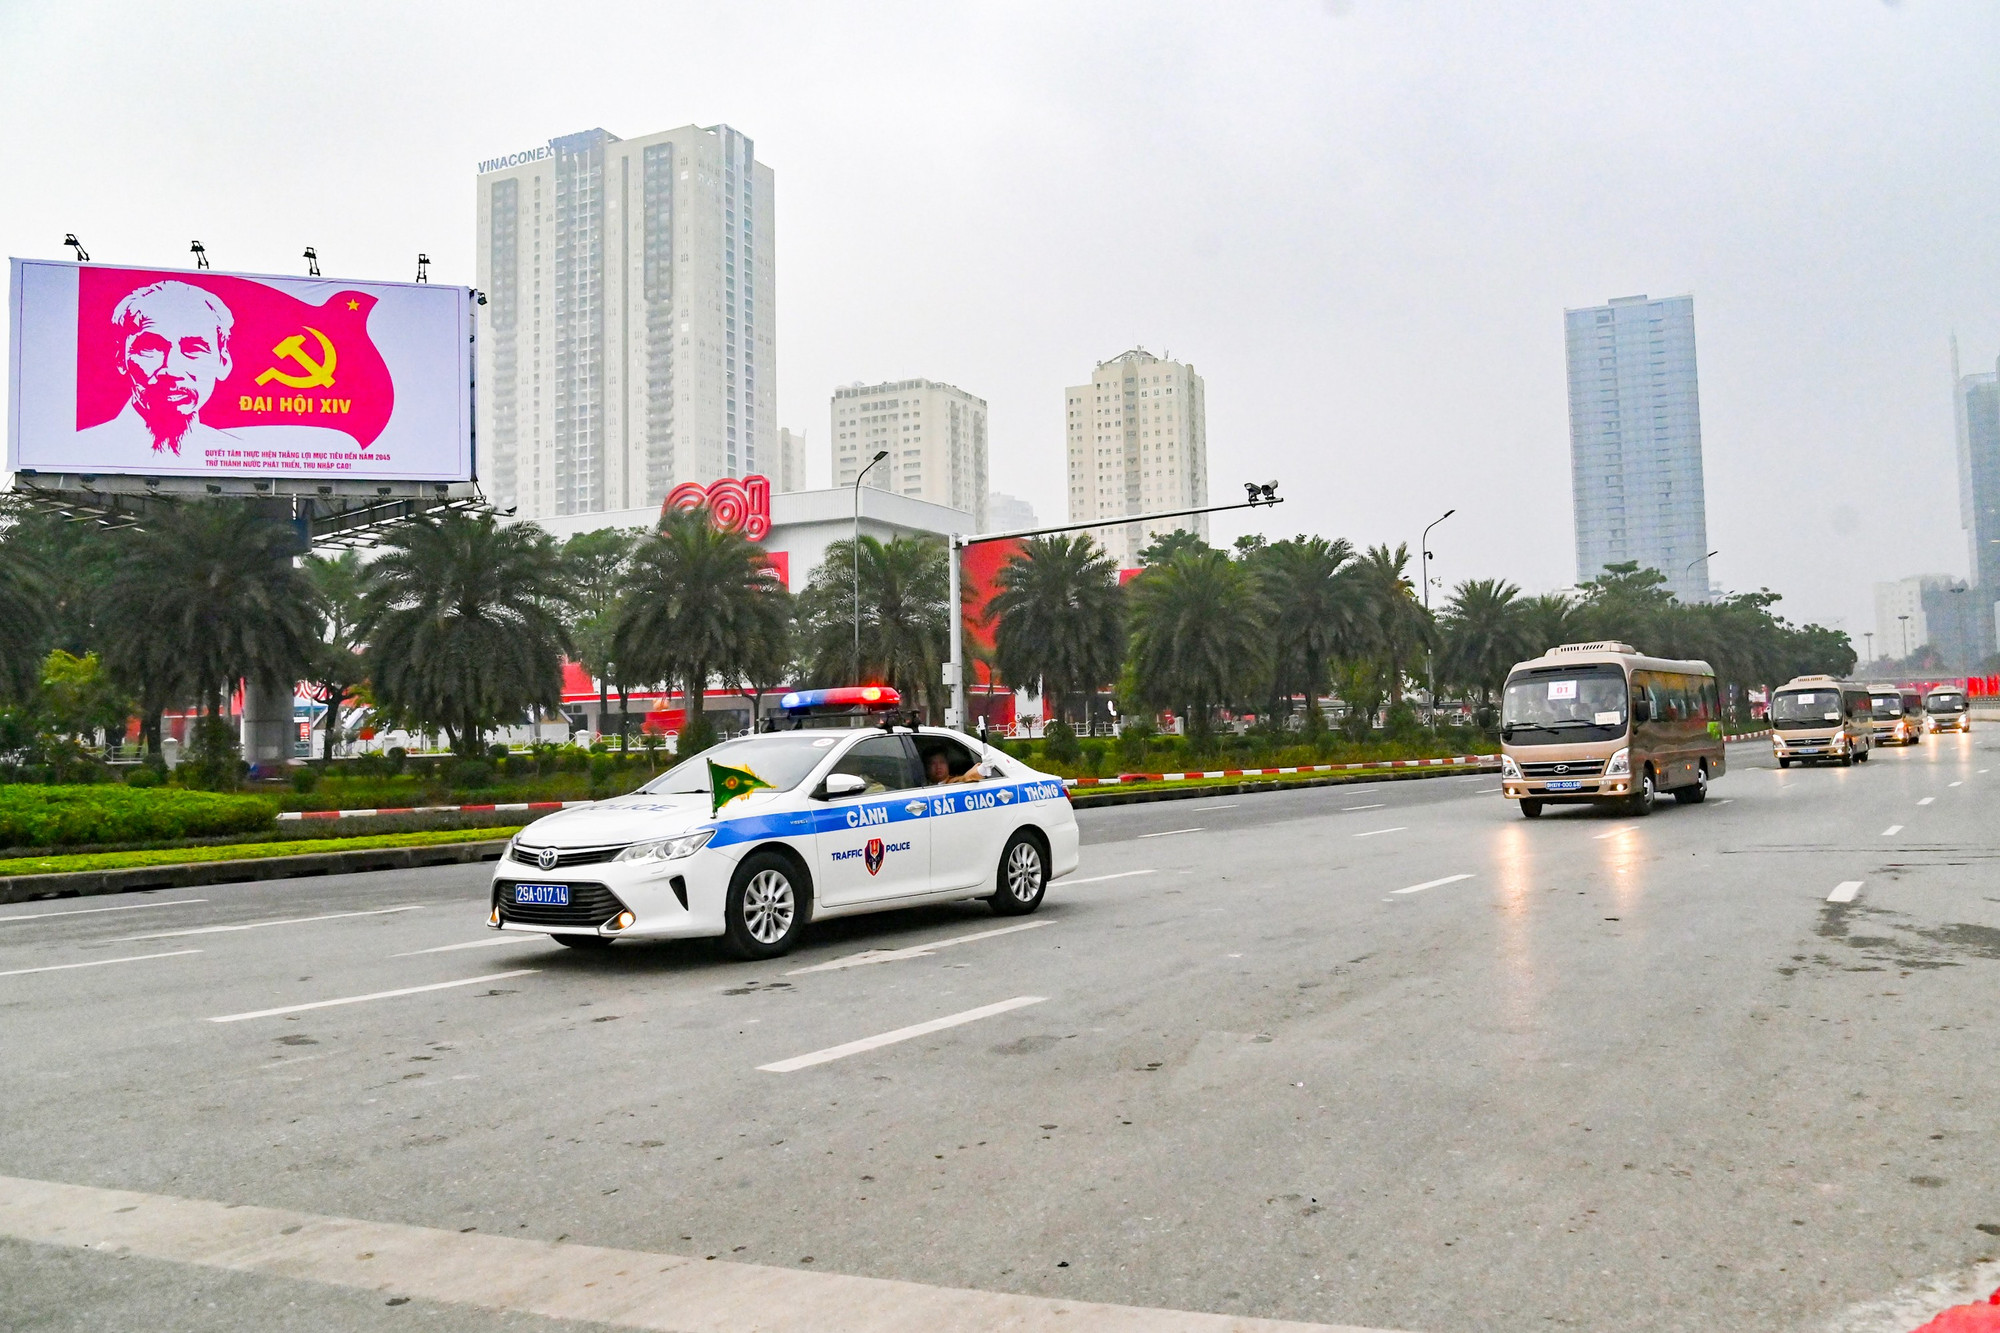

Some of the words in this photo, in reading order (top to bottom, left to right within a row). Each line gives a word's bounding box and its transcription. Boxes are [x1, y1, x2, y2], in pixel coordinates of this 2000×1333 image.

[478, 145, 554, 173] VINACONEX
[239, 395, 272, 415] ĐẠI
[280, 394, 313, 416] HỘI
[320, 398, 351, 414] XIV
[205, 447, 225, 457] QUYẾT
[227, 448, 241, 457] TÂM
[243, 450, 260, 459] THỰC
[261, 450, 277, 459] HIỆN
[278, 449, 299, 459] THẮNG
[301, 452, 311, 460] LỢI
[313, 452, 327, 460] MỤC
[329, 451, 343, 460] TIÊU
[344, 451, 357, 460] ĐẾN
[358, 452, 374, 460] NĂM
[375, 453, 391, 461] 2045
[205, 457, 219, 467] TRỞ
[220, 458, 241, 467] THÀNH
[242, 458, 261, 468] NƯỚC
[262, 460, 280, 468] PHÁT
[281, 459, 301, 469] TRIỂN,
[317, 461, 335, 470] NHẬP
[1556, 686, 1569, 694] 01
[846, 804, 889, 828] CẢNH
[934, 793, 955, 815] SÁT
[964, 792, 995, 811] GIAO
[1024, 781, 1059, 801] THÔNG
[831, 848, 863, 861] TRAFFIC
[885, 841, 911, 853] POLICE
[517, 886, 567, 903] 29A-017.14
